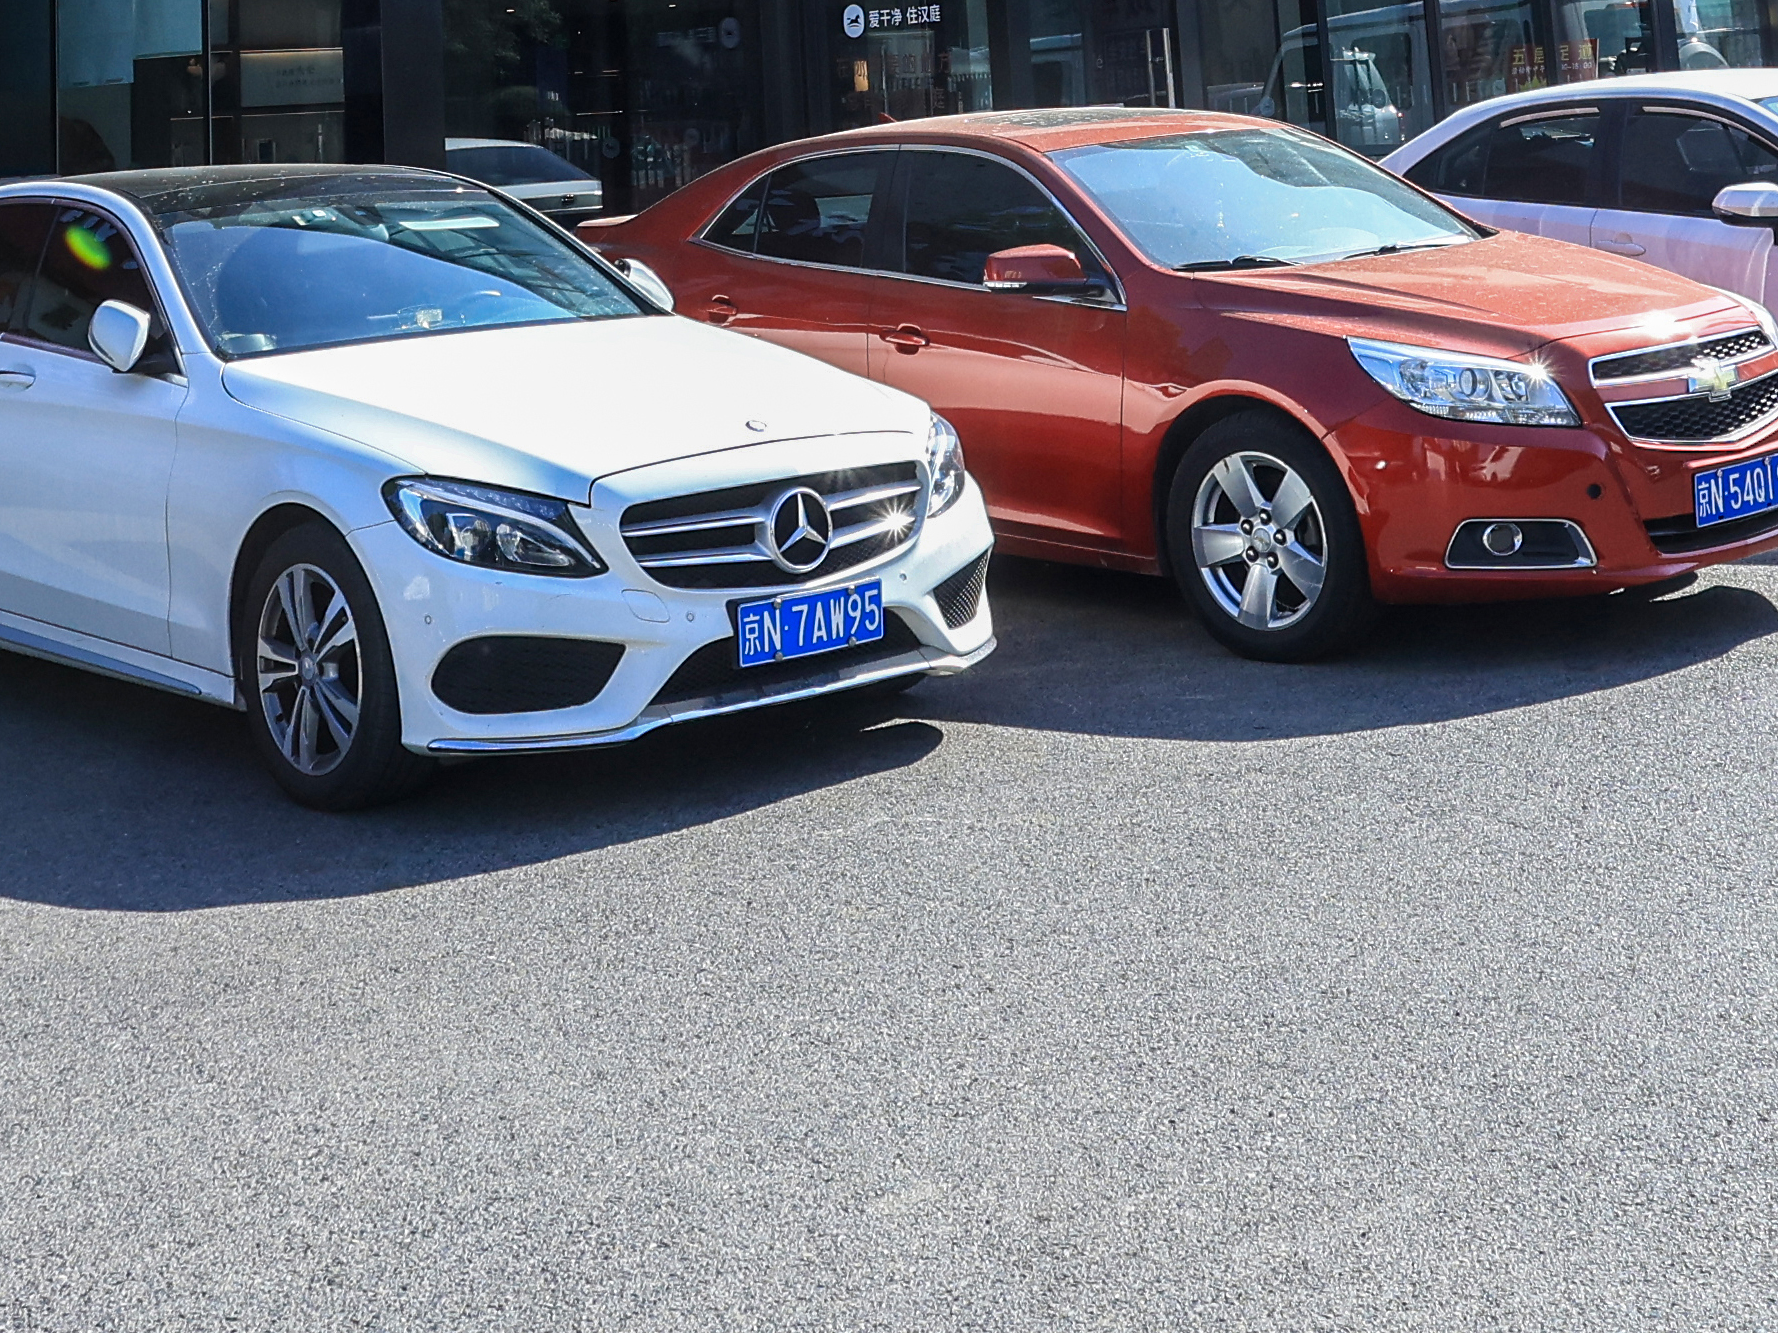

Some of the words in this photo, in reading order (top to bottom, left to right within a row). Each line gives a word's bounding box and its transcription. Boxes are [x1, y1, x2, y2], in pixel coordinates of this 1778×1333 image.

[868, 8, 903, 29] 爱干净
[906, 4, 942, 25] 住汉庭
[743, 588, 880, 656] 京N·7AW95
